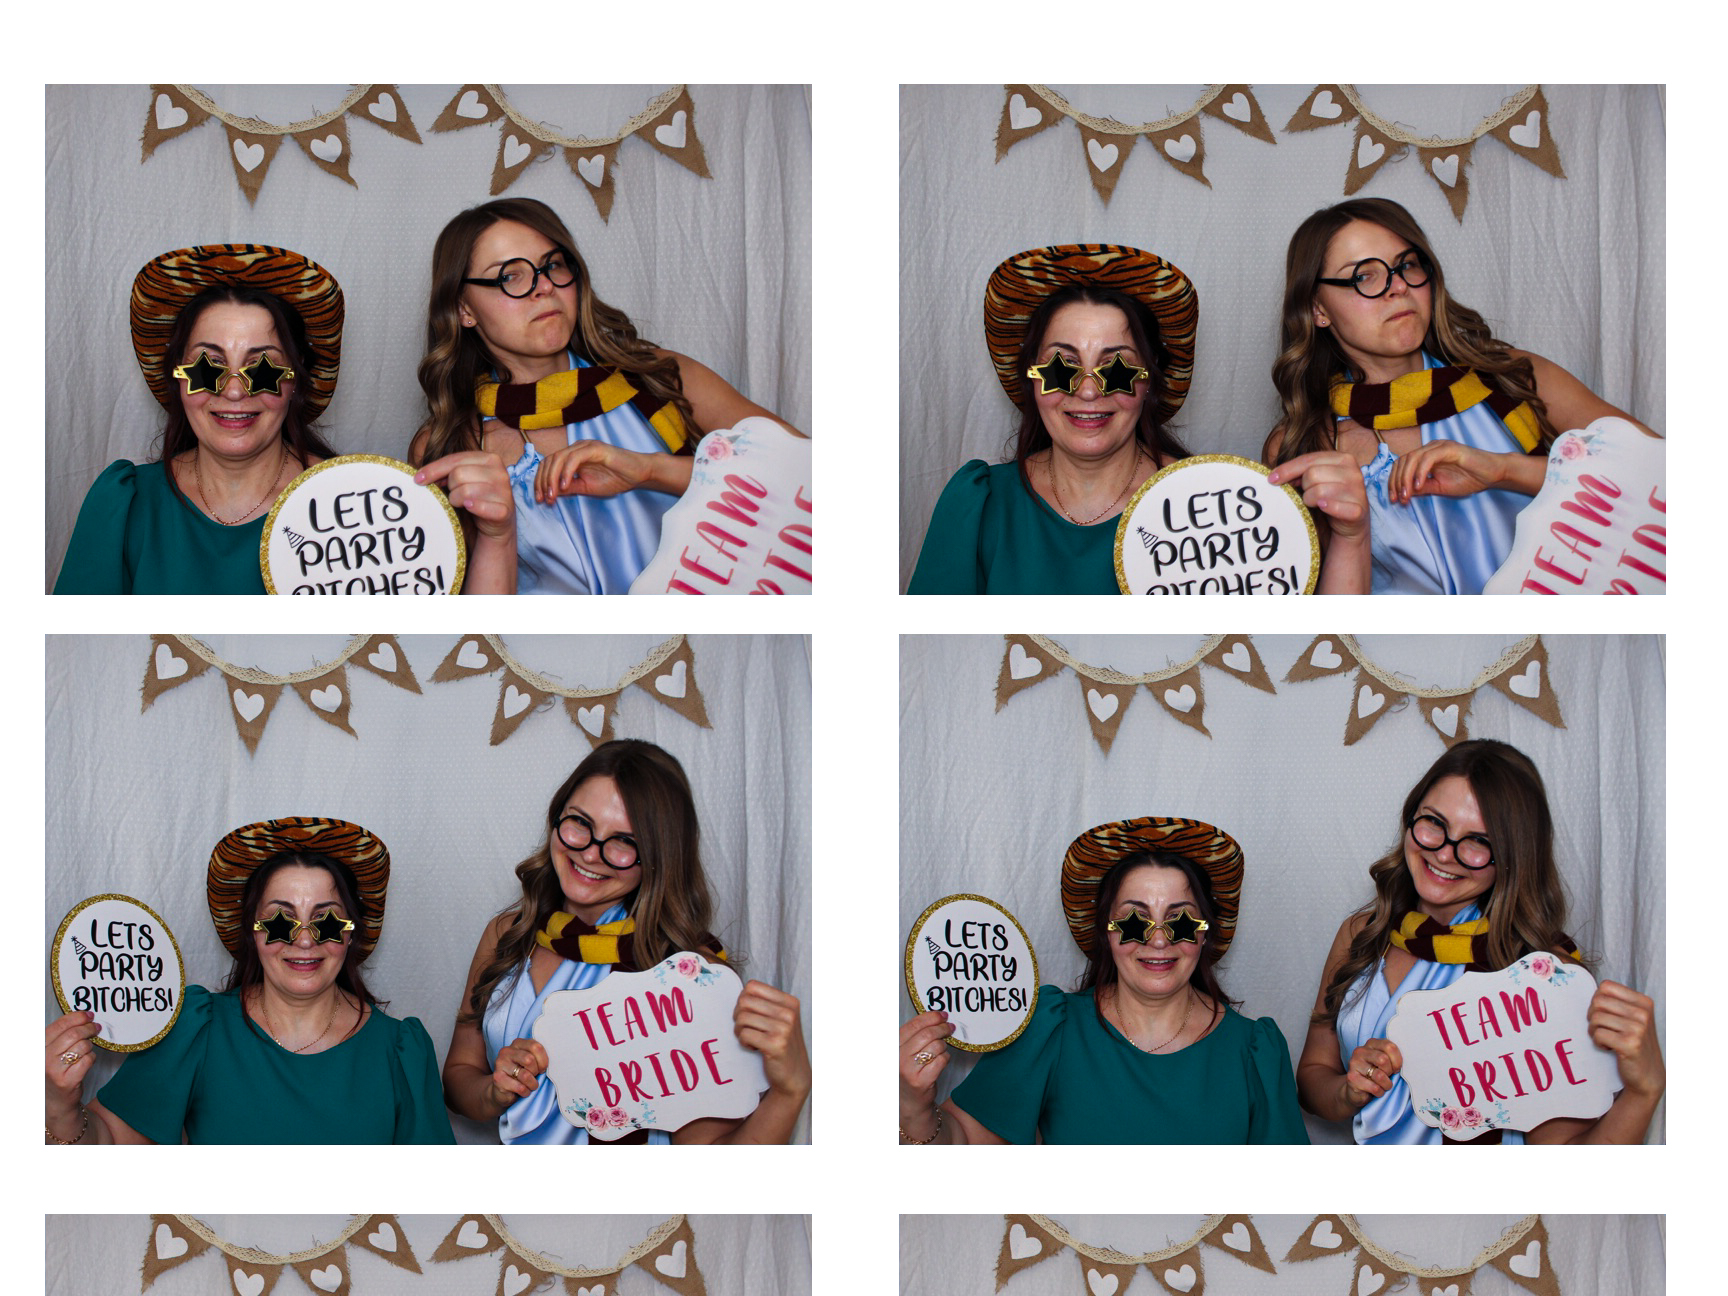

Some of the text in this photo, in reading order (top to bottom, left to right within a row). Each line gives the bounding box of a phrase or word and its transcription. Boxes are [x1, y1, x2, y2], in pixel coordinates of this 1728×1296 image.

[309, 485, 409, 533] LETS
[1163, 485, 1263, 533] LETS
[295, 526, 426, 577] PARTY
[666, 474, 768, 595] TEAM
[1149, 526, 1280, 577] PARTY
[1520, 474, 1622, 595] TEAM
[90, 918, 155, 951] LETS
[944, 918, 1009, 951] LETS
[79, 950, 164, 982] PARTY
[933, 950, 1018, 982] PARTY
[72, 986, 174, 1013] BITCHES!
[572, 986, 694, 1051] TEAM
[926, 986, 1028, 1013] BITCHES!
[1426, 986, 1548, 1051] TEAM
[594, 1038, 733, 1108] BRIDE
[1448, 1038, 1587, 1108] BRIDE
